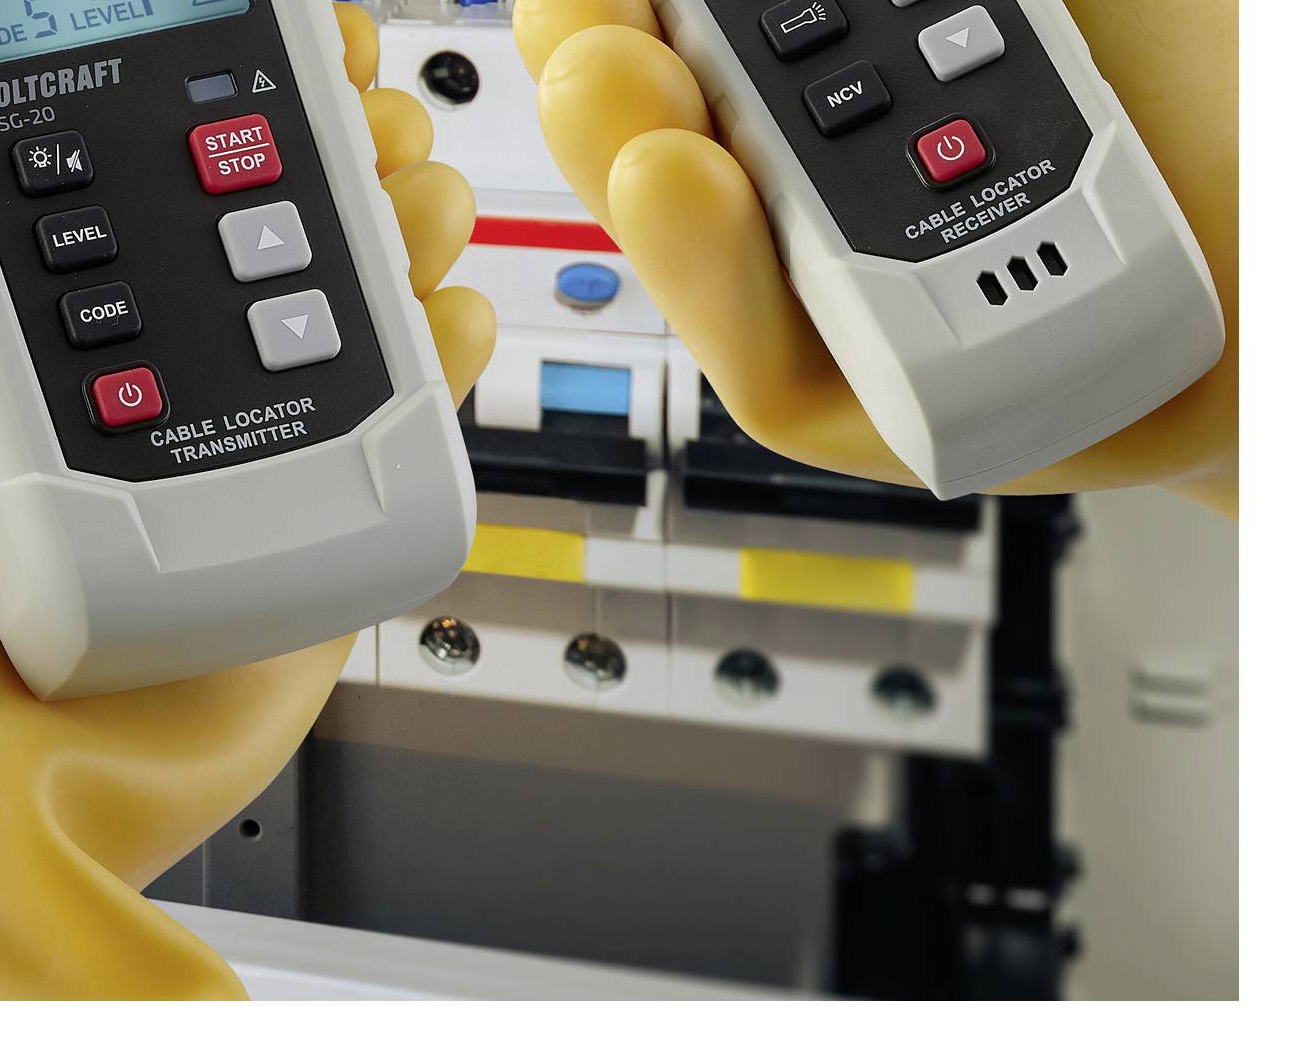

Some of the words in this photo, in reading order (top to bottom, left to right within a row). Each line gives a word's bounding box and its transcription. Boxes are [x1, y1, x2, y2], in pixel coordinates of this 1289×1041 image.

[70, 1, 143, 32] LEVEL
[826, 82, 863, 108] NCV
[205, 126, 263, 152] START
[218, 153, 267, 176] STOP
[904, 200, 966, 241] CABLE
[970, 158, 1056, 208] LOCATOR
[940, 192, 1030, 243] RECEIVER
[52, 225, 107, 249] LEVEL
[80, 301, 128, 323] CODE
[150, 419, 216, 448] CABLE
[223, 396, 316, 431] LOCATOR
[170, 421, 308, 465] TRANSMITTER
